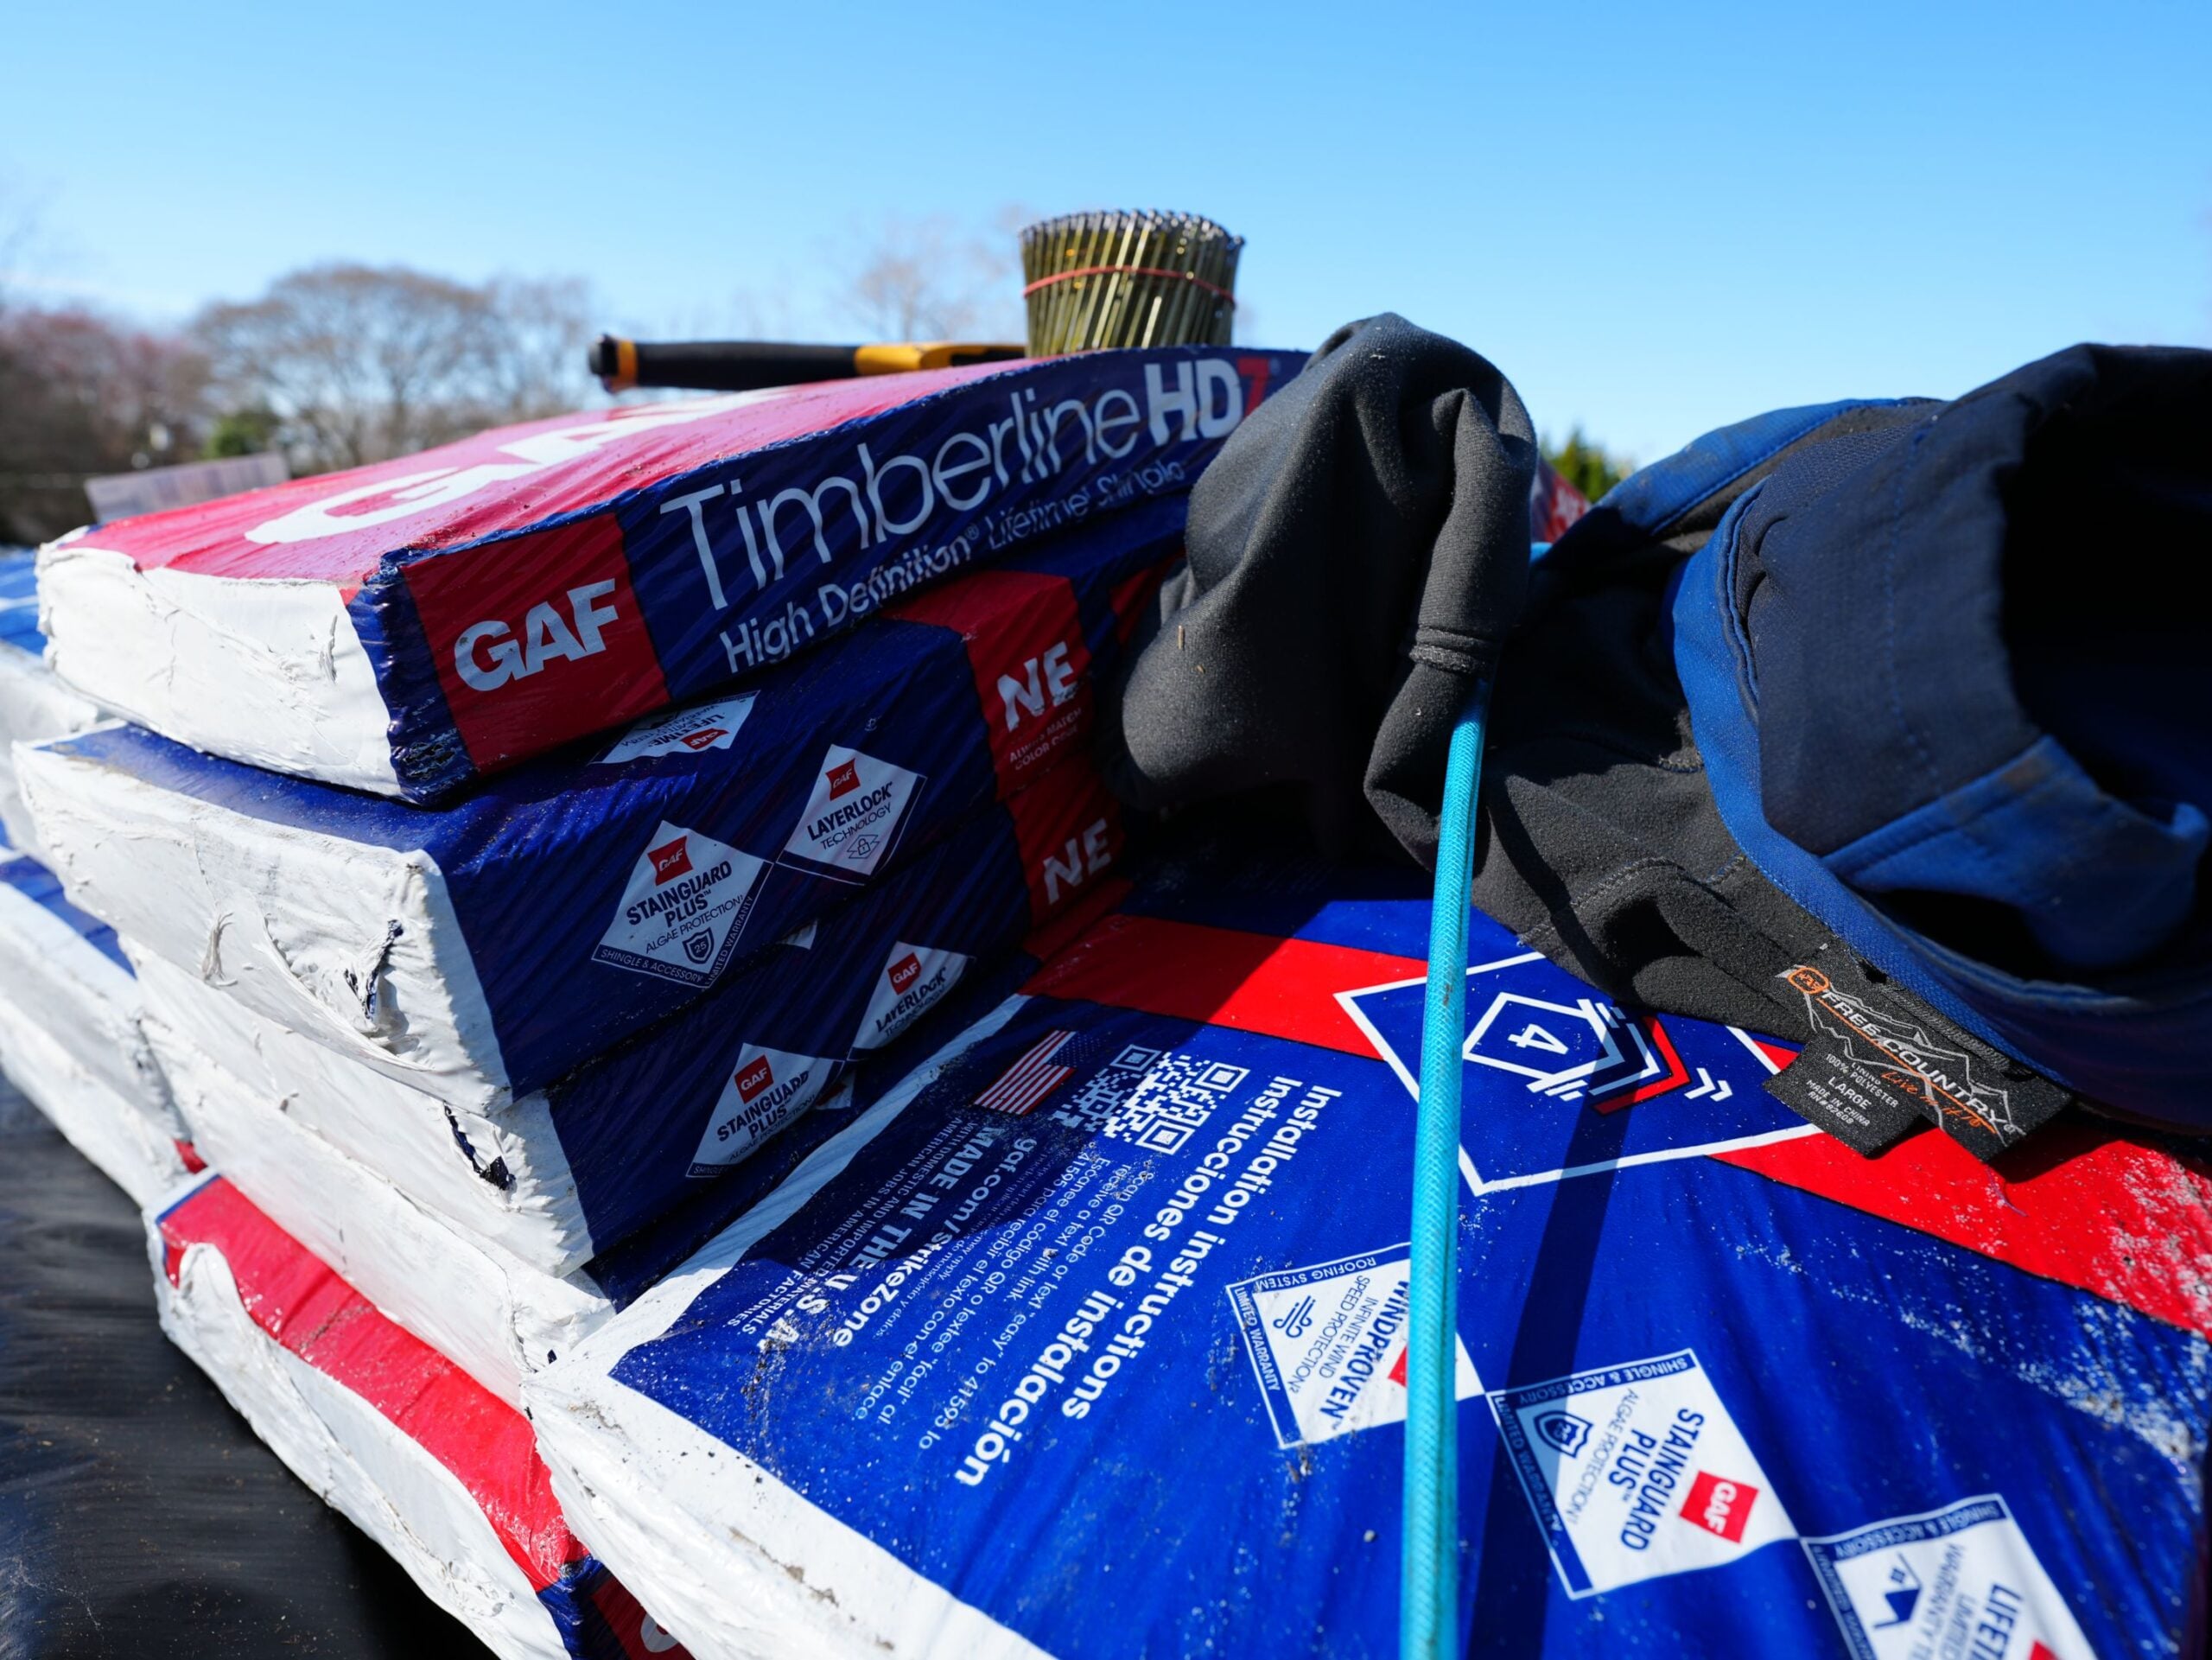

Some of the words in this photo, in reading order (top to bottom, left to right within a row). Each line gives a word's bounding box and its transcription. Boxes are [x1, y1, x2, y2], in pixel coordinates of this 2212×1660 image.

[454, 578, 620, 691] GAF
[719, 605, 811, 674] High
[996, 641, 1077, 732] NE
[820, 802, 891, 850] TECHNOLOGY
[658, 847, 684, 870] GAF
[1043, 818, 1111, 905] NE
[623, 861, 733, 927] STAINGUARD
[646, 928, 677, 953] ALGAE
[726, 896, 753, 946] WARRANTY
[600, 949, 641, 966] SHINGLE
[893, 961, 919, 983] GAF
[1821, 991, 1881, 1038] FREE
[1508, 1023, 1570, 1055] 4
[740, 1066, 769, 1091] GAF
[1825, 1053, 1850, 1074] 100%
[1849, 1071, 1899, 1108] POLYESTER
[1827, 1076, 1872, 1110] LARGE
[1805, 1078, 1831, 1098] MADE
[1830, 1097, 1843, 1107] IN
[1843, 1105, 1871, 1127] CHINA
[906, 1117, 963, 1167] AMERICAN
[946, 1122, 978, 1145] WITH
[894, 1147, 951, 1195] DOMESTIC
[926, 1127, 1005, 1189] MADE
[1051, 1152, 1091, 1187] 41595
[1139, 1076, 1304, 1242] Instrucciones
[1204, 1085, 1342, 1226] Installation
[876, 1168, 908, 1194] JOBS
[1052, 1157, 1112, 1207] Escanee
[1084, 1163, 1136, 1208] receive
[861, 1196, 880, 1209] IN
[870, 1196, 899, 1218] AND
[898, 1192, 941, 1219] IN
[1020, 1187, 1056, 1217] para
[1040, 1208, 1061, 1221] el
[1074, 1209, 1095, 1219] a
[1096, 1203, 1128, 1225] QR
[798, 1209, 864, 1269] AMERICAN
[811, 1218, 875, 1278] IMPORTED
[828, 1137, 1040, 1347] gaf.com/StrikeZone
[847, 1224, 912, 1270] THE
[983, 1218, 1028, 1259] recibir
[998, 1221, 1048, 1269] código
[1063, 1224, 1109, 1261] Code
[970, 1258, 990, 1275] el
[977, 1269, 1007, 1294] QR
[1047, 1263, 1070, 1282] or
[1100, 1244, 1148, 1288] de
[1255, 1273, 1305, 1291] SYSTEM
[1312, 1257, 1376, 1278] ROOFING
[942, 1274, 978, 1307] texto
[967, 1293, 986, 1306] o
[1001, 1275, 1037, 1302] link.
[1338, 1274, 1370, 1313] SPEED
[912, 1310, 945, 1340] con
[1056, 1230, 1221, 1420] instructions
[1236, 1287, 1255, 1324] LIMITED
[1249, 1328, 1279, 1390] WARRANTY
[1339, 1295, 1377, 1345] INFINITE
[1317, 1341, 1348, 1380] WIND
[1608, 1370, 1620, 1383] &
[1623, 1358, 1687, 1377] SHINGLE
[950, 1289, 1123, 1489] instalación
[1521, 1374, 1604, 1402] ACCESSORY
[876, 1402, 896, 1425] al
[1608, 1388, 1640, 1435] ALGAE
[1618, 1406, 1704, 1554] STAINGUARD
[1702, 1477, 1738, 1532] GAF
